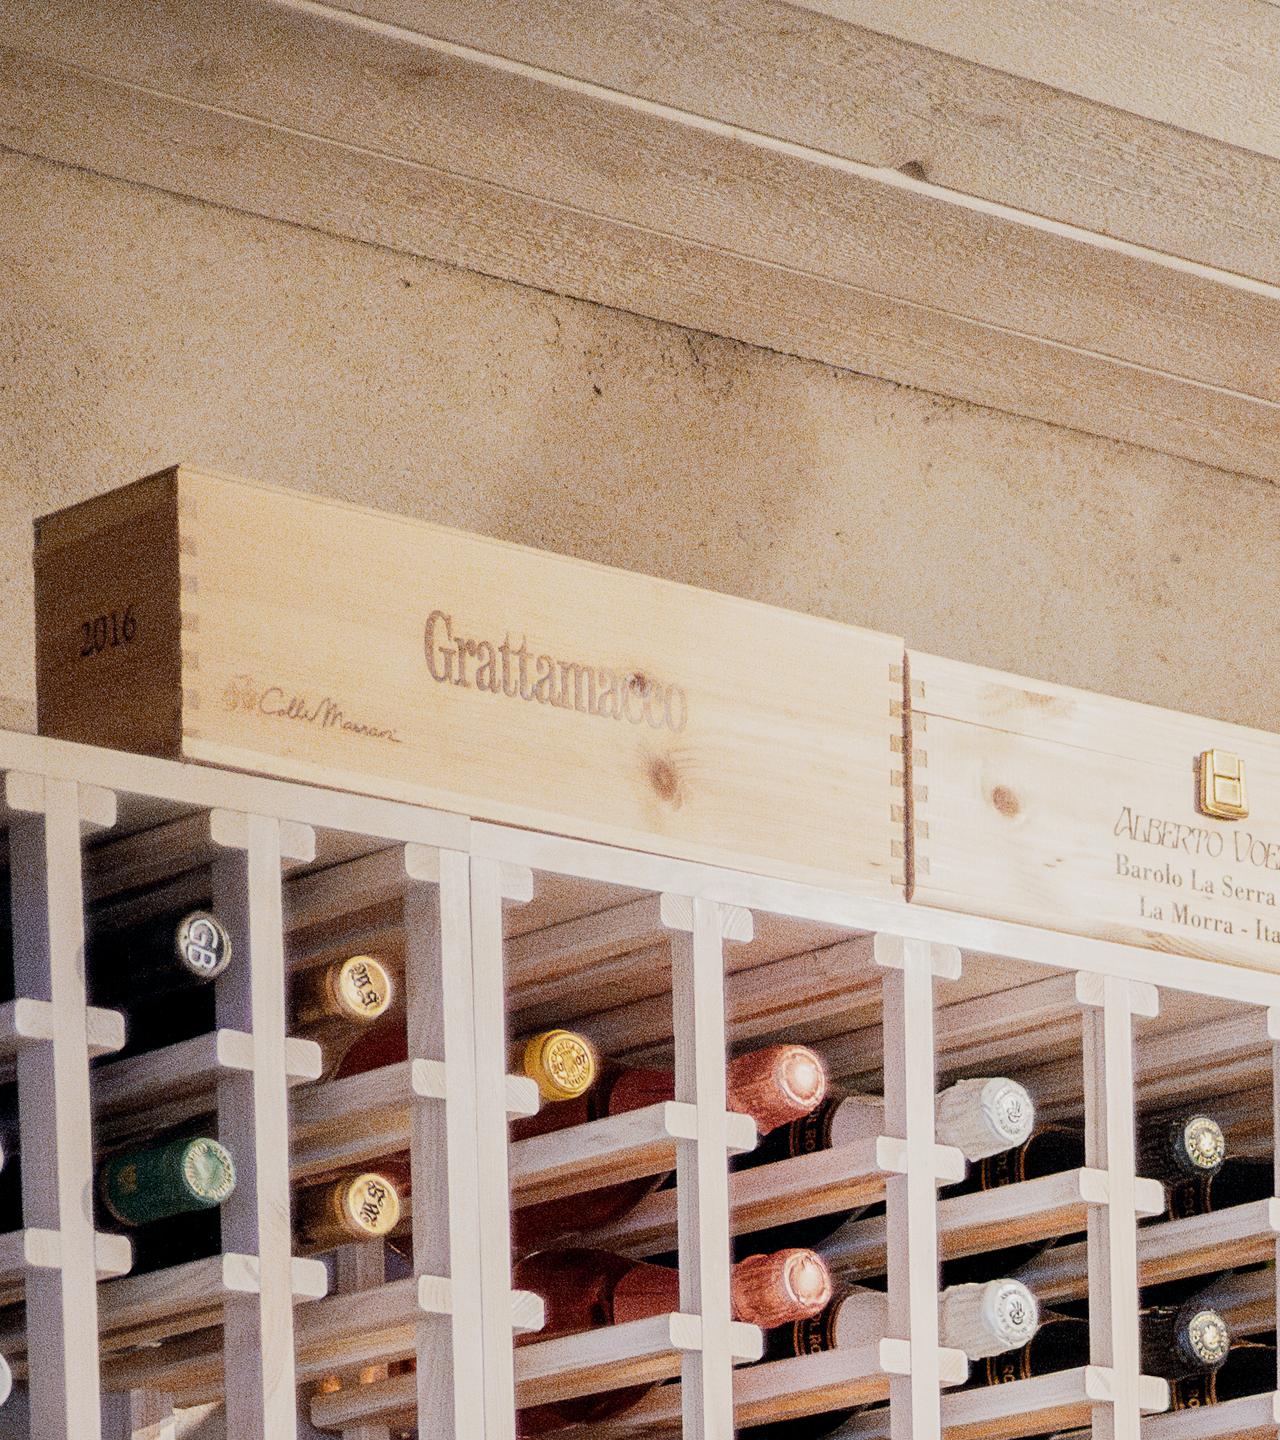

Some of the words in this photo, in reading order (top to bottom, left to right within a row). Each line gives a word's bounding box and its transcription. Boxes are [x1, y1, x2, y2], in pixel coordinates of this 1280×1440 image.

[79, 603, 138, 658] 2016
[423, 609, 689, 734] Grattamacco
[1115, 851, 1184, 889] Barolo
[1190, 867, 1215, 895] La
[1221, 874, 1277, 907] Serra
[1139, 894, 1164, 921] La
[1171, 901, 1234, 936] Morra
